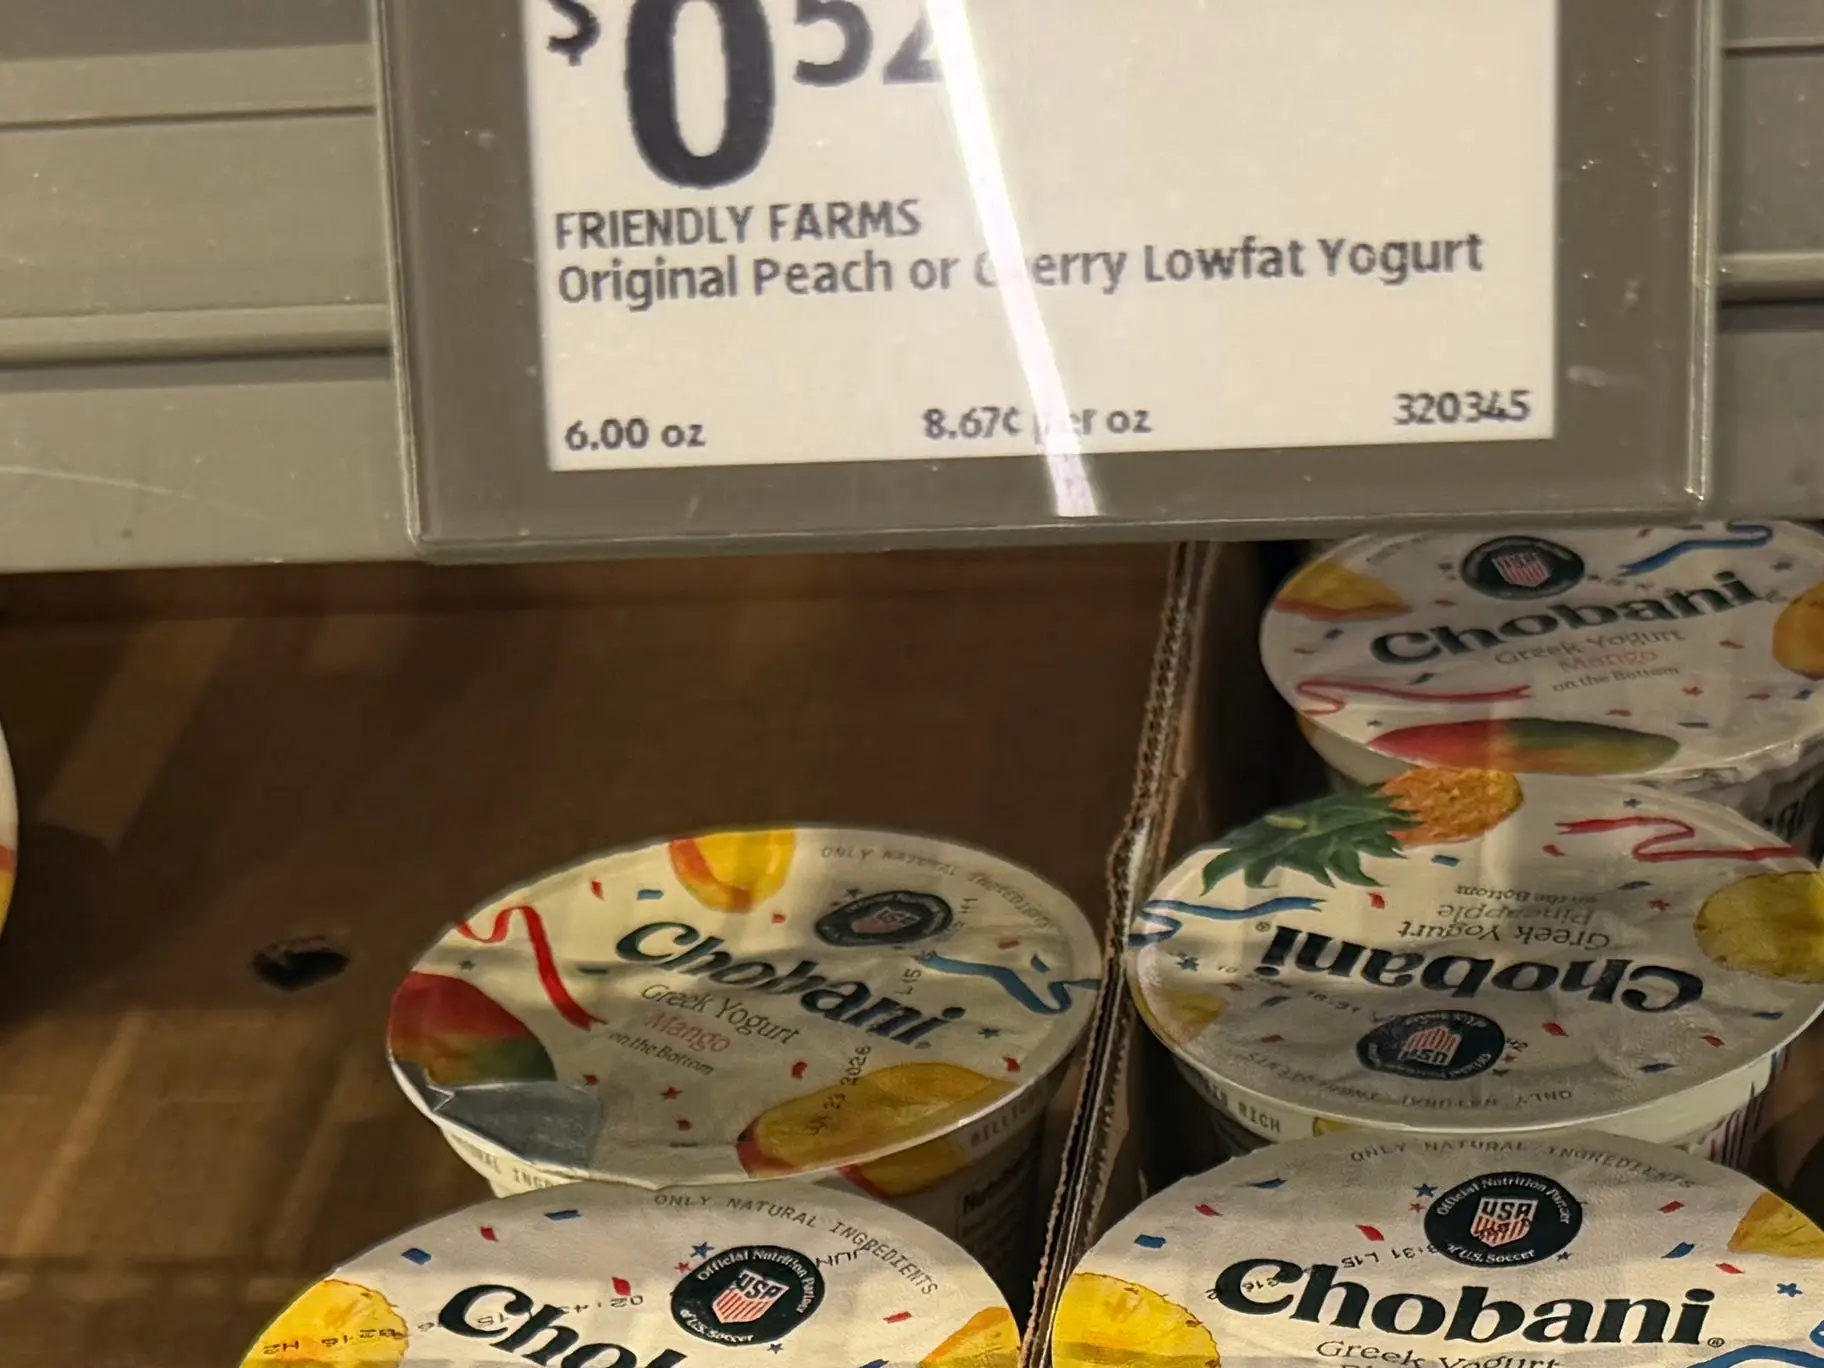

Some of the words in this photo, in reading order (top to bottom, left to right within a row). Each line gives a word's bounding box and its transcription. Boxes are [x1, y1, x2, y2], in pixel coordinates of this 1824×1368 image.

[552, 205, 755, 250] FRIENDLY
[768, 199, 922, 245] FARMS
[556, 253, 738, 312] Original
[751, 248, 893, 299] Peach
[909, 251, 960, 293] or
[972, 243, 1127, 297] Cerry
[1143, 234, 1307, 286] Lowfat
[1318, 230, 1484, 287] Yogurt
[564, 416, 648, 452] 6.00
[660, 419, 706, 449] oz
[922, 405, 1023, 441] 8.67¢
[1110, 402, 1152, 437] oz
[1394, 389, 1531, 427] 320345
[1370, 571, 1763, 665] Chobani
[1398, 919, 1501, 944] Yogurt
[1513, 927, 1611, 948] Greek
[614, 922, 966, 1045] Chobani
[1254, 925, 1705, 1012] Chobani
[717, 989, 801, 1049] Yogurt
[1482, 1177, 1547, 1192] Nutrition
[1482, 1198, 1537, 1223] USA
[653, 1194, 711, 1207] ONLY
[727, 1198, 817, 1228] NATURAL
[829, 1222, 939, 1295] INGREDIENTS
[697, 1250, 749, 1281] Official
[1486, 1249, 1535, 1264] Soccer
[1215, 1257, 1718, 1347] Chobani
